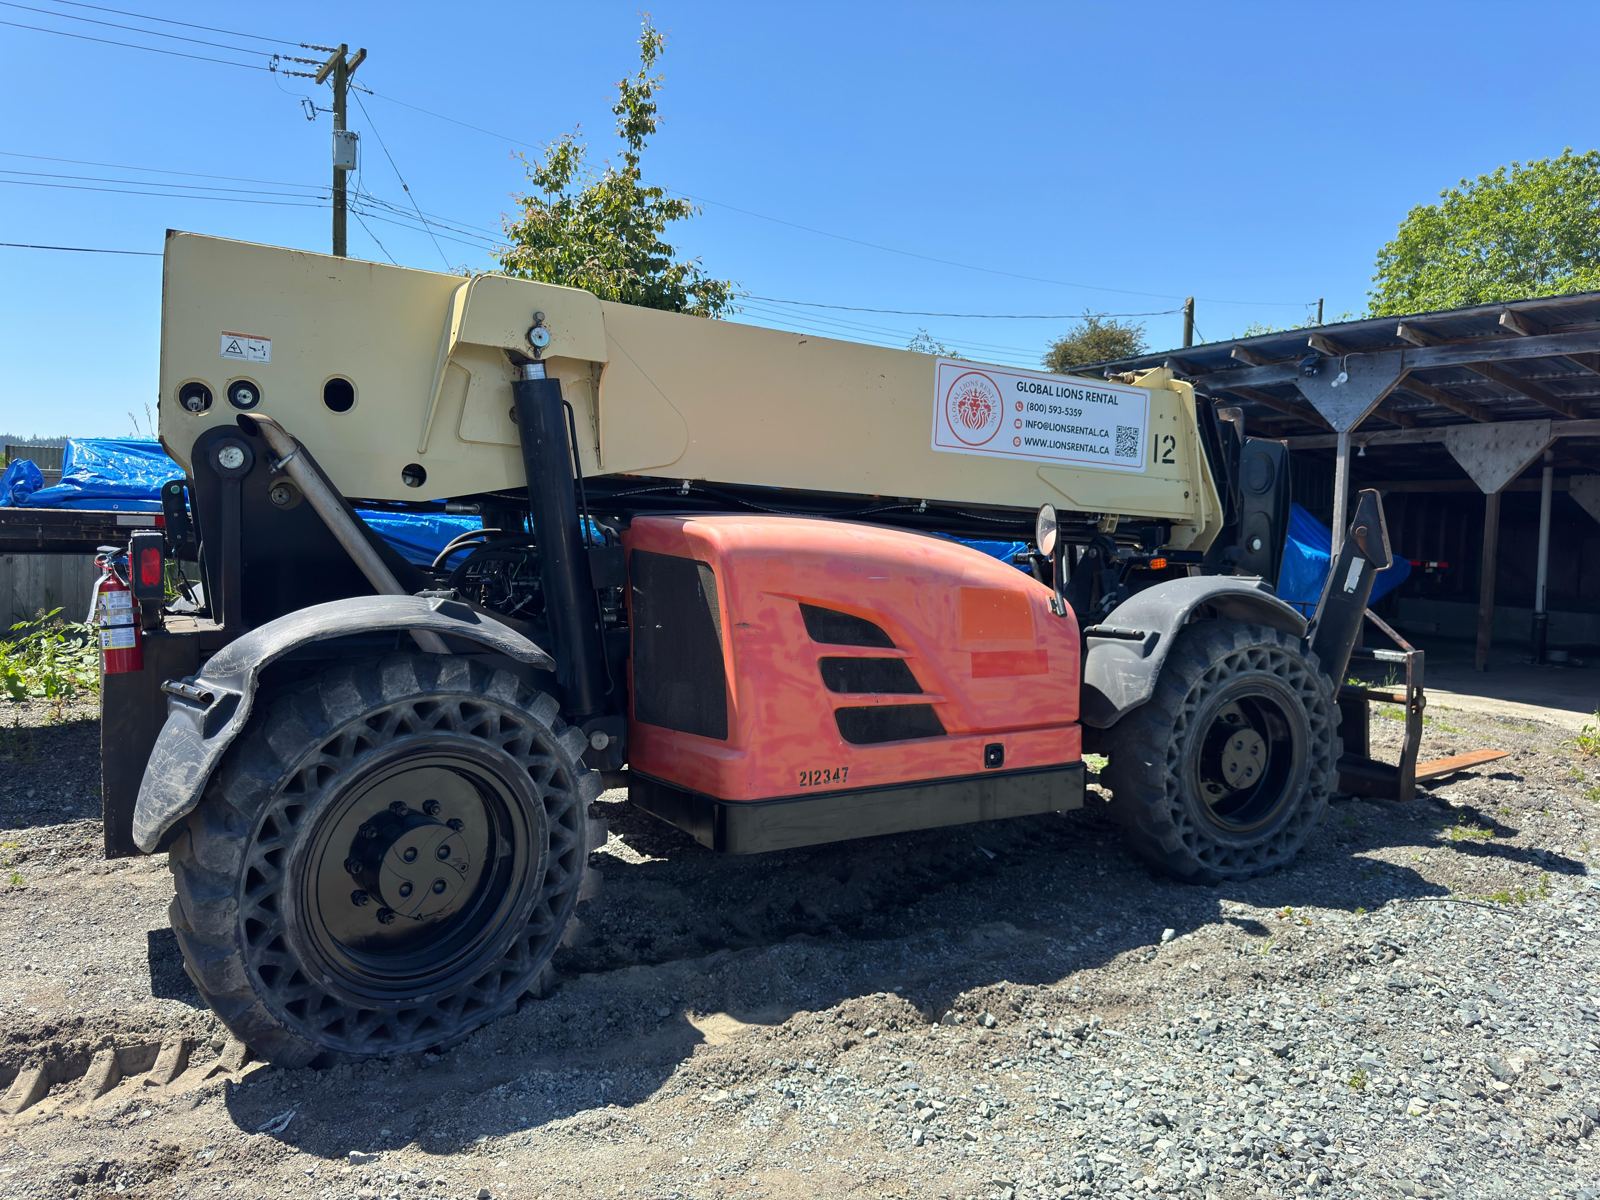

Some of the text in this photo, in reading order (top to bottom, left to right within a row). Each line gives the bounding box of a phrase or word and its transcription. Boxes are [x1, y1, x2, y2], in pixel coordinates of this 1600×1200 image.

[1016, 381, 1119, 406] GLOBAL LIONS RENTAL
[1026, 402, 1083, 417] (800) 593-5359
[1025, 420, 1110, 438] INFO@LIONSRENTAL.CA
[1024, 437, 1110, 455] WWW.LIONSRENTAL.CA
[1153, 433, 1177, 464] 12
[799, 766, 849, 787] 212347
